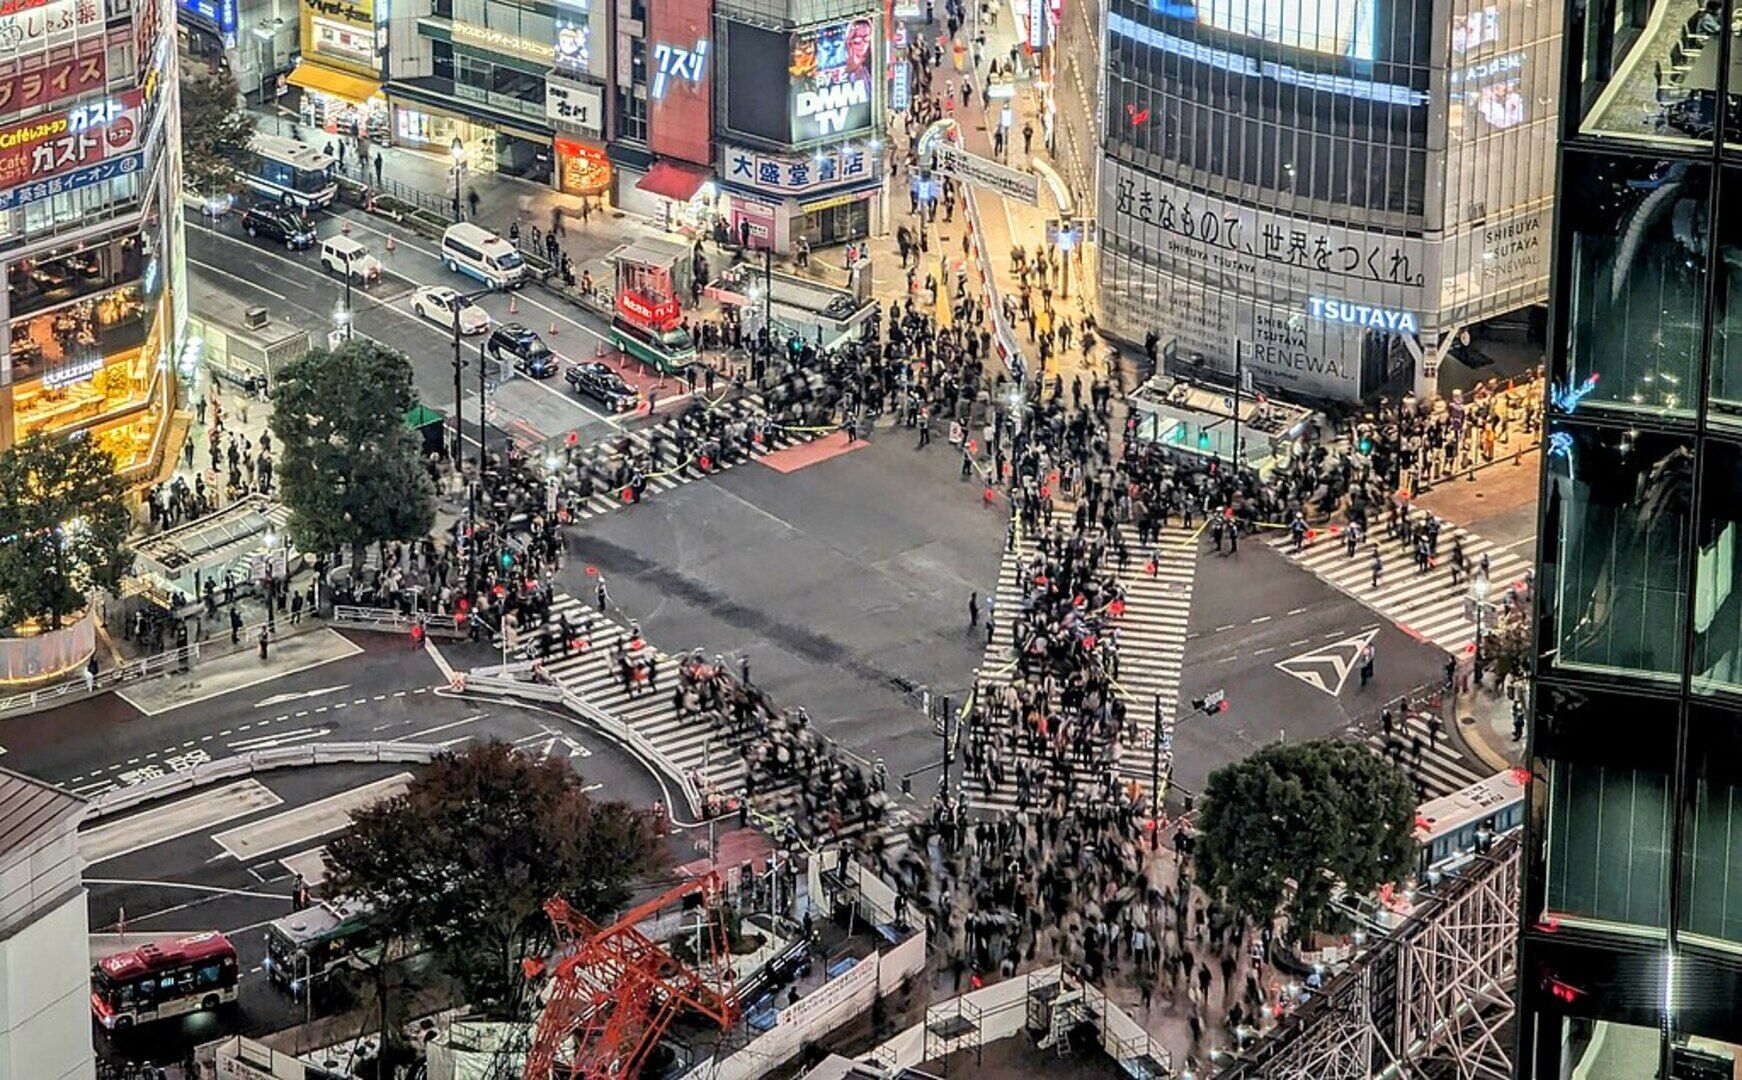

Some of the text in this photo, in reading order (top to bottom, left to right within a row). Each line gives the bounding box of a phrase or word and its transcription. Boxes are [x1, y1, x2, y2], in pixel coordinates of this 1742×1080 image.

[796, 79, 869, 116] DMM
[69, 99, 124, 132] ガスト
[814, 106, 850, 134] TV
[32, 134, 97, 175] ガスト
[733, 151, 864, 185] 大盛堂書店
[1117, 176, 1426, 287] 好きなもので、世界をつくれ。
[1486, 217, 1540, 244] SHIBUYA
[1168, 240, 1209, 264] SHIBUYA
[1213, 254, 1256, 274] TSUTAYA
[1486, 236, 1539, 260] SUTAYA
[1308, 297, 1417, 332] TSUTAYA
[1257, 329, 1307, 349] TSUTAYA
